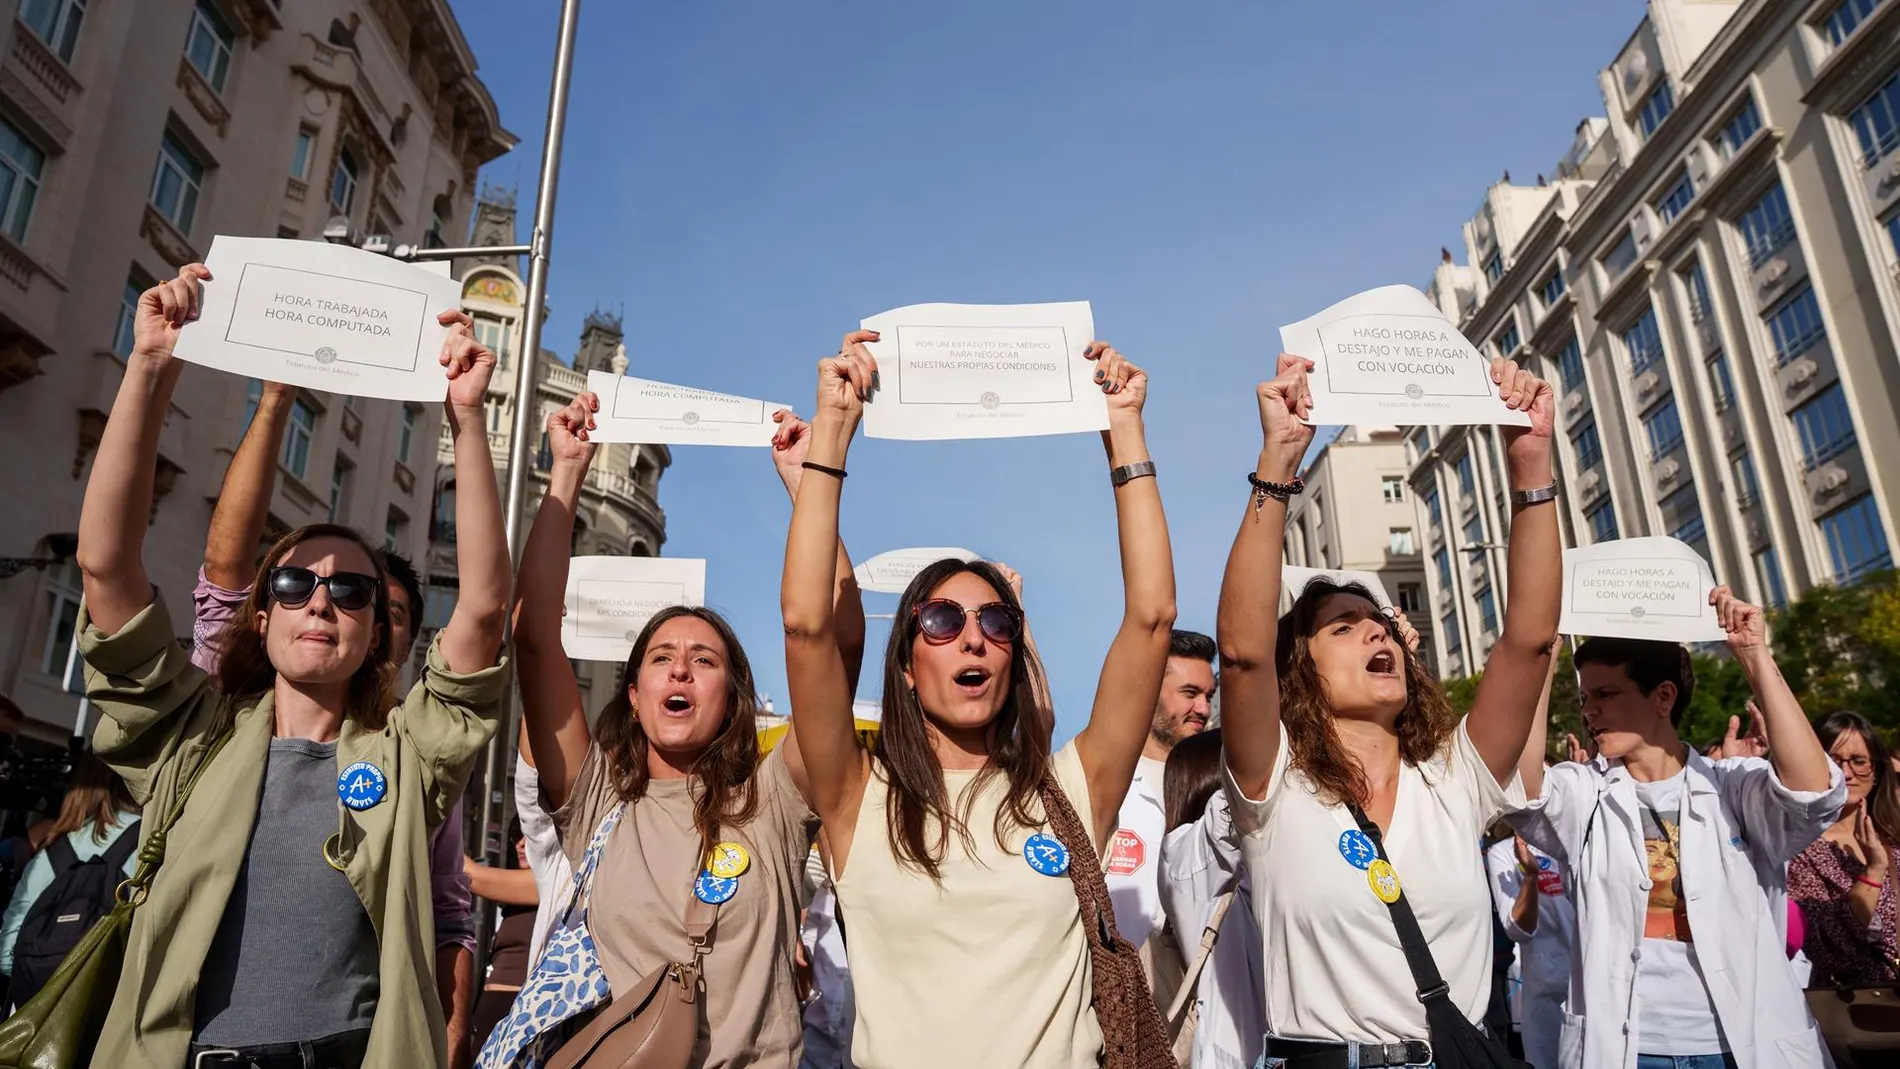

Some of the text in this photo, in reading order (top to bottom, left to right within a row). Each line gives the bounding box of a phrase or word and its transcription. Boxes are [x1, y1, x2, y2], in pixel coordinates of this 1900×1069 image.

[274, 292, 388, 320] HORA TRABAJADA
[265, 308, 391, 337] HORA COMPUTADA
[1353, 328, 1449, 342] HAGO HORAS A
[998, 341, 1014, 349] DEL
[950, 350, 1019, 359] PARA NEGOCIAR
[1337, 343, 1469, 360] DESTAJO Y ME PAGAN
[910, 361, 1057, 371] NUESTRAS PROPIAS CONDICIONES
[1357, 360, 1455, 375] CON VOCACIÓN
[640, 390, 741, 404] HORA COMPUTADA
[1597, 568, 1627, 576] HAGO
[1630, 568, 1666, 576] HORAS
[1583, 580, 1625, 588] DESTAJO
[1636, 580, 1651, 588] ME
[1654, 581, 1690, 589] PAGAN
[1596, 590, 1676, 601] CON VOCACIÓN
[1115, 837, 1138, 847] TOP
